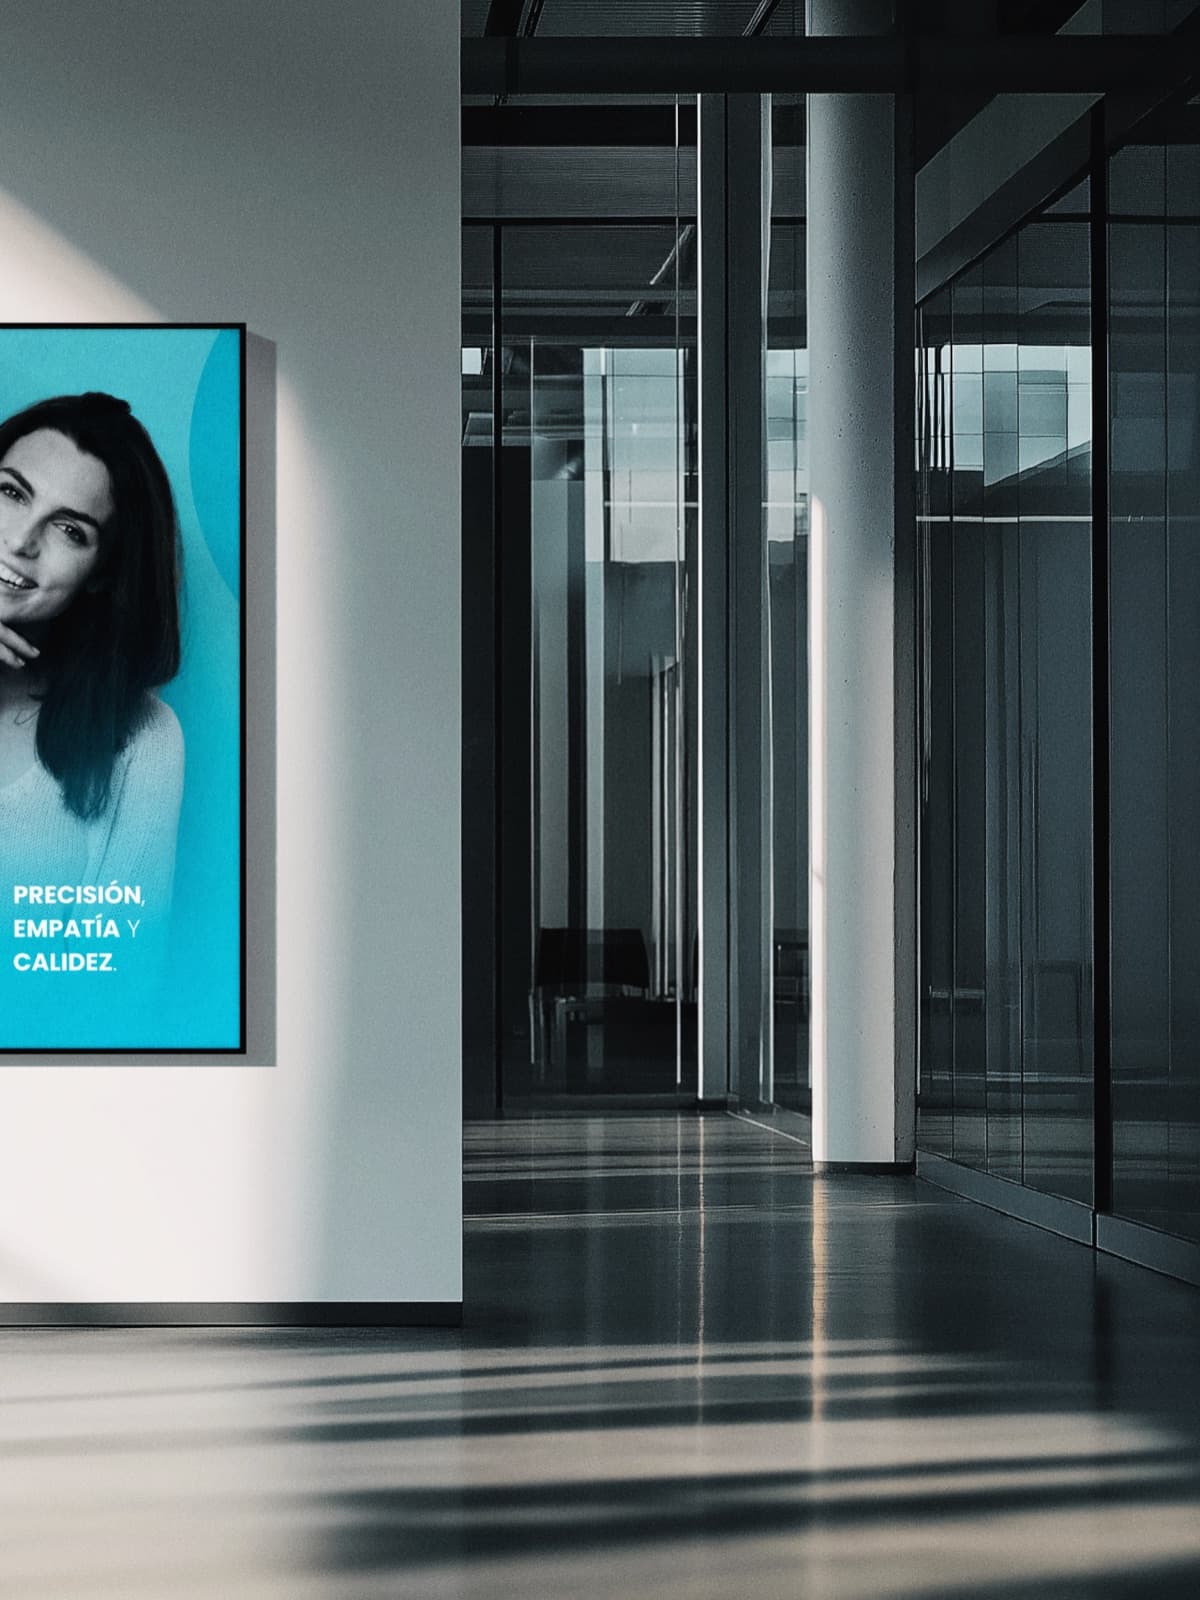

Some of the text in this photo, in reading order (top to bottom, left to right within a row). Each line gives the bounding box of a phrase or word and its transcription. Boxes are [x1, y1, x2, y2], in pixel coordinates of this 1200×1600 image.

[13, 880, 145, 907] PRECISIÓN,
[13, 913, 140, 938] EMPATÍA Y
[13, 952, 117, 971] CALIDEZ.
